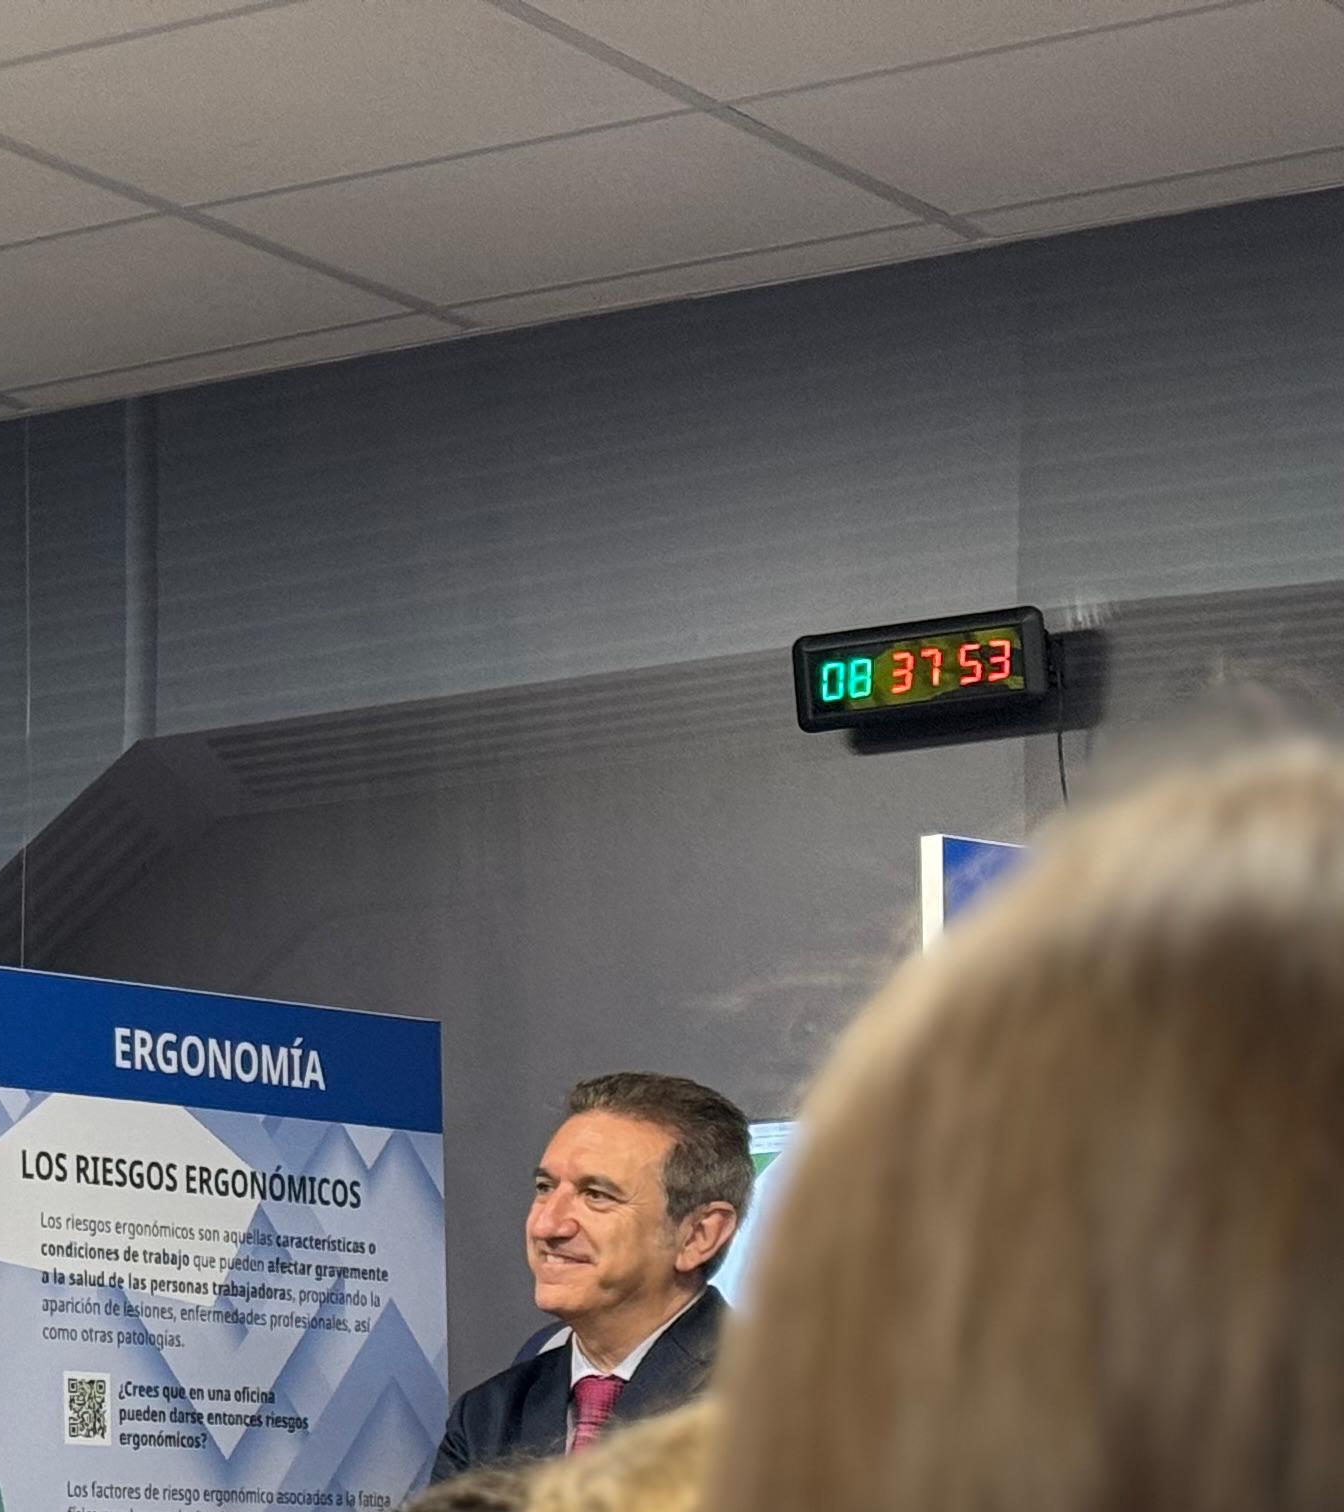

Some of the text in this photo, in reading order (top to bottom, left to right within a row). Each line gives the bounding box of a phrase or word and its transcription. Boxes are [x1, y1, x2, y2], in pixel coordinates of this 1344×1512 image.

[821, 639, 1011, 701] 08 37 53
[114, 1028, 326, 1091] ERGONOMÍA
[21, 1150, 362, 1209] LOS RIESGOS ERGONÓMICOS
[40, 1211, 376, 1254] Los riesgos ergonómicos son aquellas características o
[40, 1241, 388, 1282] condiciones de trabajo que pueden afectar gravemente
[42, 1268, 380, 1307] a la salud de las personas trabajadoras, propiciando la
[42, 1297, 370, 1333] aparición de lesiones, enfermedades profesionales, así
[42, 1326, 185, 1349] como otras patologías.
[118, 1381, 275, 1404] ¿Crees que en una oficina
[119, 1406, 309, 1433] pueden darse entonces riesgos
[119, 1430, 207, 1450] ergonómicos?
[67, 1481, 391, 1512] Los factores de riesgo ergonómico asociados a la fatiga
